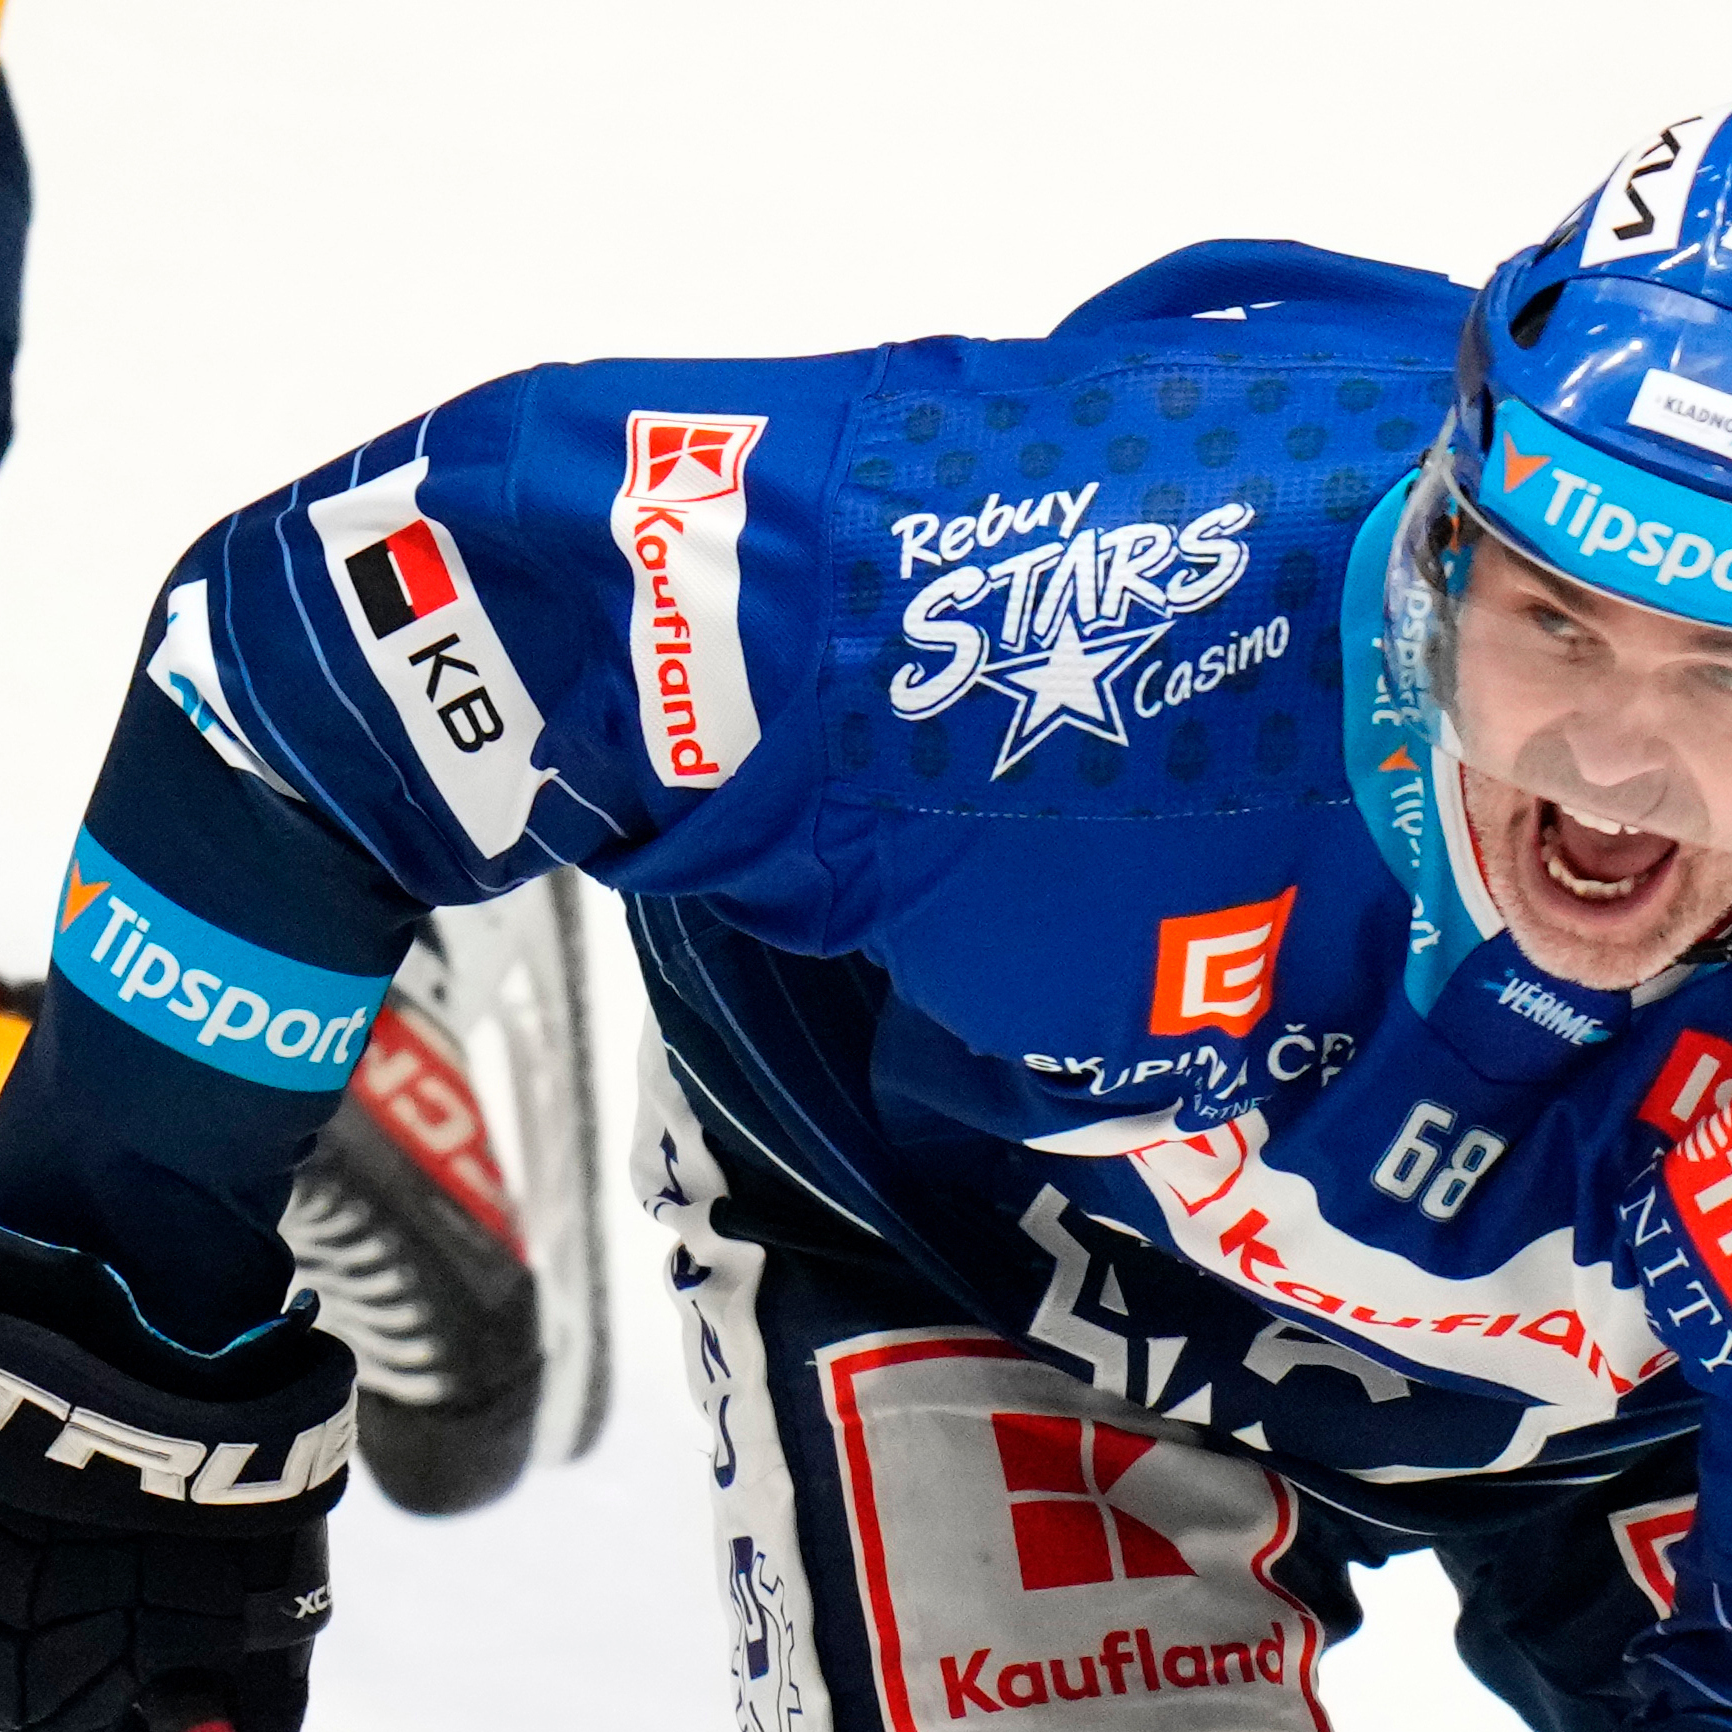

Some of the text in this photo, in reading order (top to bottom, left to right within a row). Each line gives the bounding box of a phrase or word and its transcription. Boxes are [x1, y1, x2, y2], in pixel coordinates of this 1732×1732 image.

[891, 482, 1100, 579] Rebuy
[633, 506, 721, 776] Kaufland
[890, 502, 1255, 721] STARS
[1133, 616, 1291, 718] Casino
[408, 633, 505, 755] KB
[89, 895, 368, 1065] Tipsport
[1370, 1099, 1508, 1224] 68
[939, 1627, 1287, 1720] Kaufland
